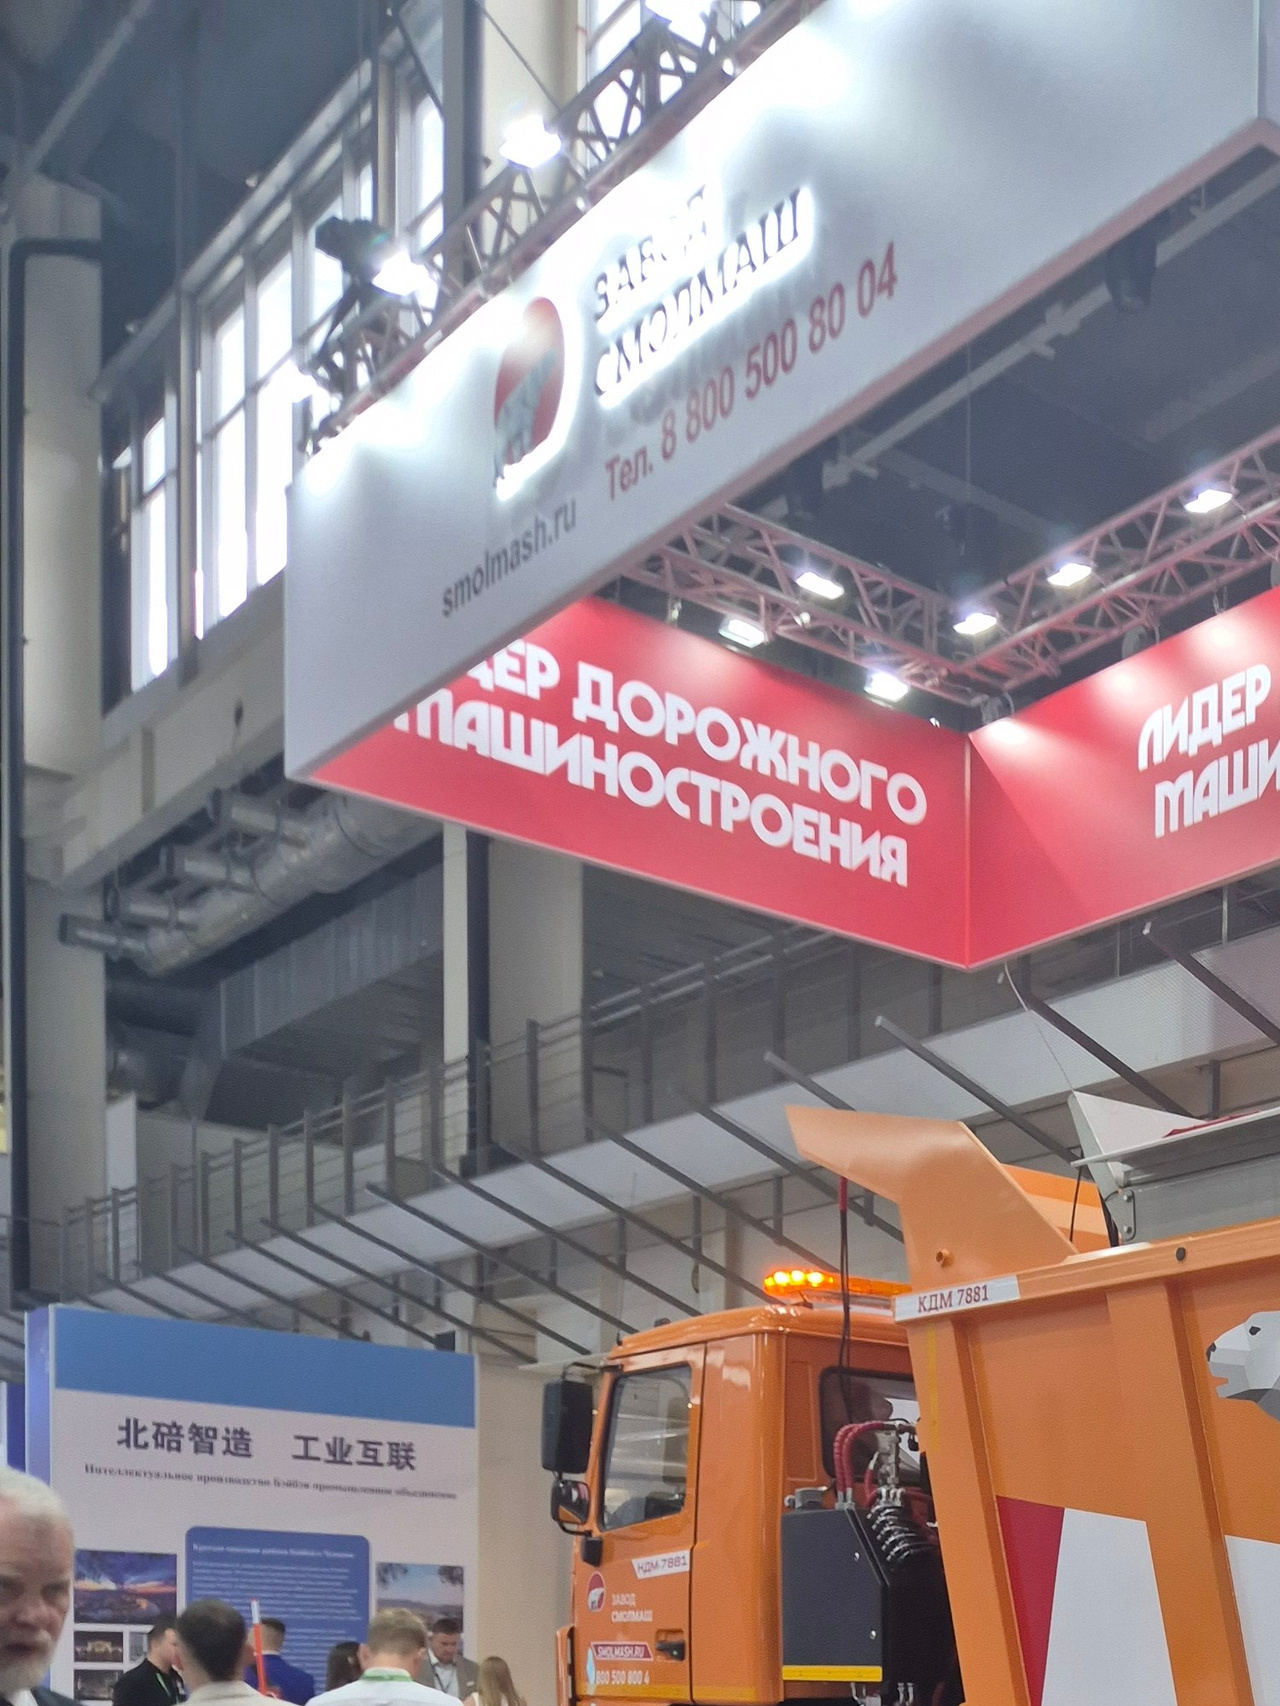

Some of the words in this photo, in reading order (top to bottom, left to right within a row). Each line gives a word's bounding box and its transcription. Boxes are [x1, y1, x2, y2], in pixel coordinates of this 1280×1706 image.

[605, 446, 653, 501] Тел.
[661, 408, 677, 461] 8
[686, 365, 735, 443] 800
[745, 318, 798, 400] 500
[808, 282, 846, 354] 80
[857, 240, 898, 318] 04
[442, 499, 577, 617] smolmash.ru
[572, 661, 928, 826] ДОРОЖНОГО
[1138, 662, 1272, 771] ЛИДЕР
[917, 1291, 953, 1313] КДМ
[957, 1284, 989, 1305] 7881
[117, 1417, 253, 1458] 北碚智造
[292, 1434, 416, 1471] 工业互联
[661, 1556, 687, 1569] 7881
